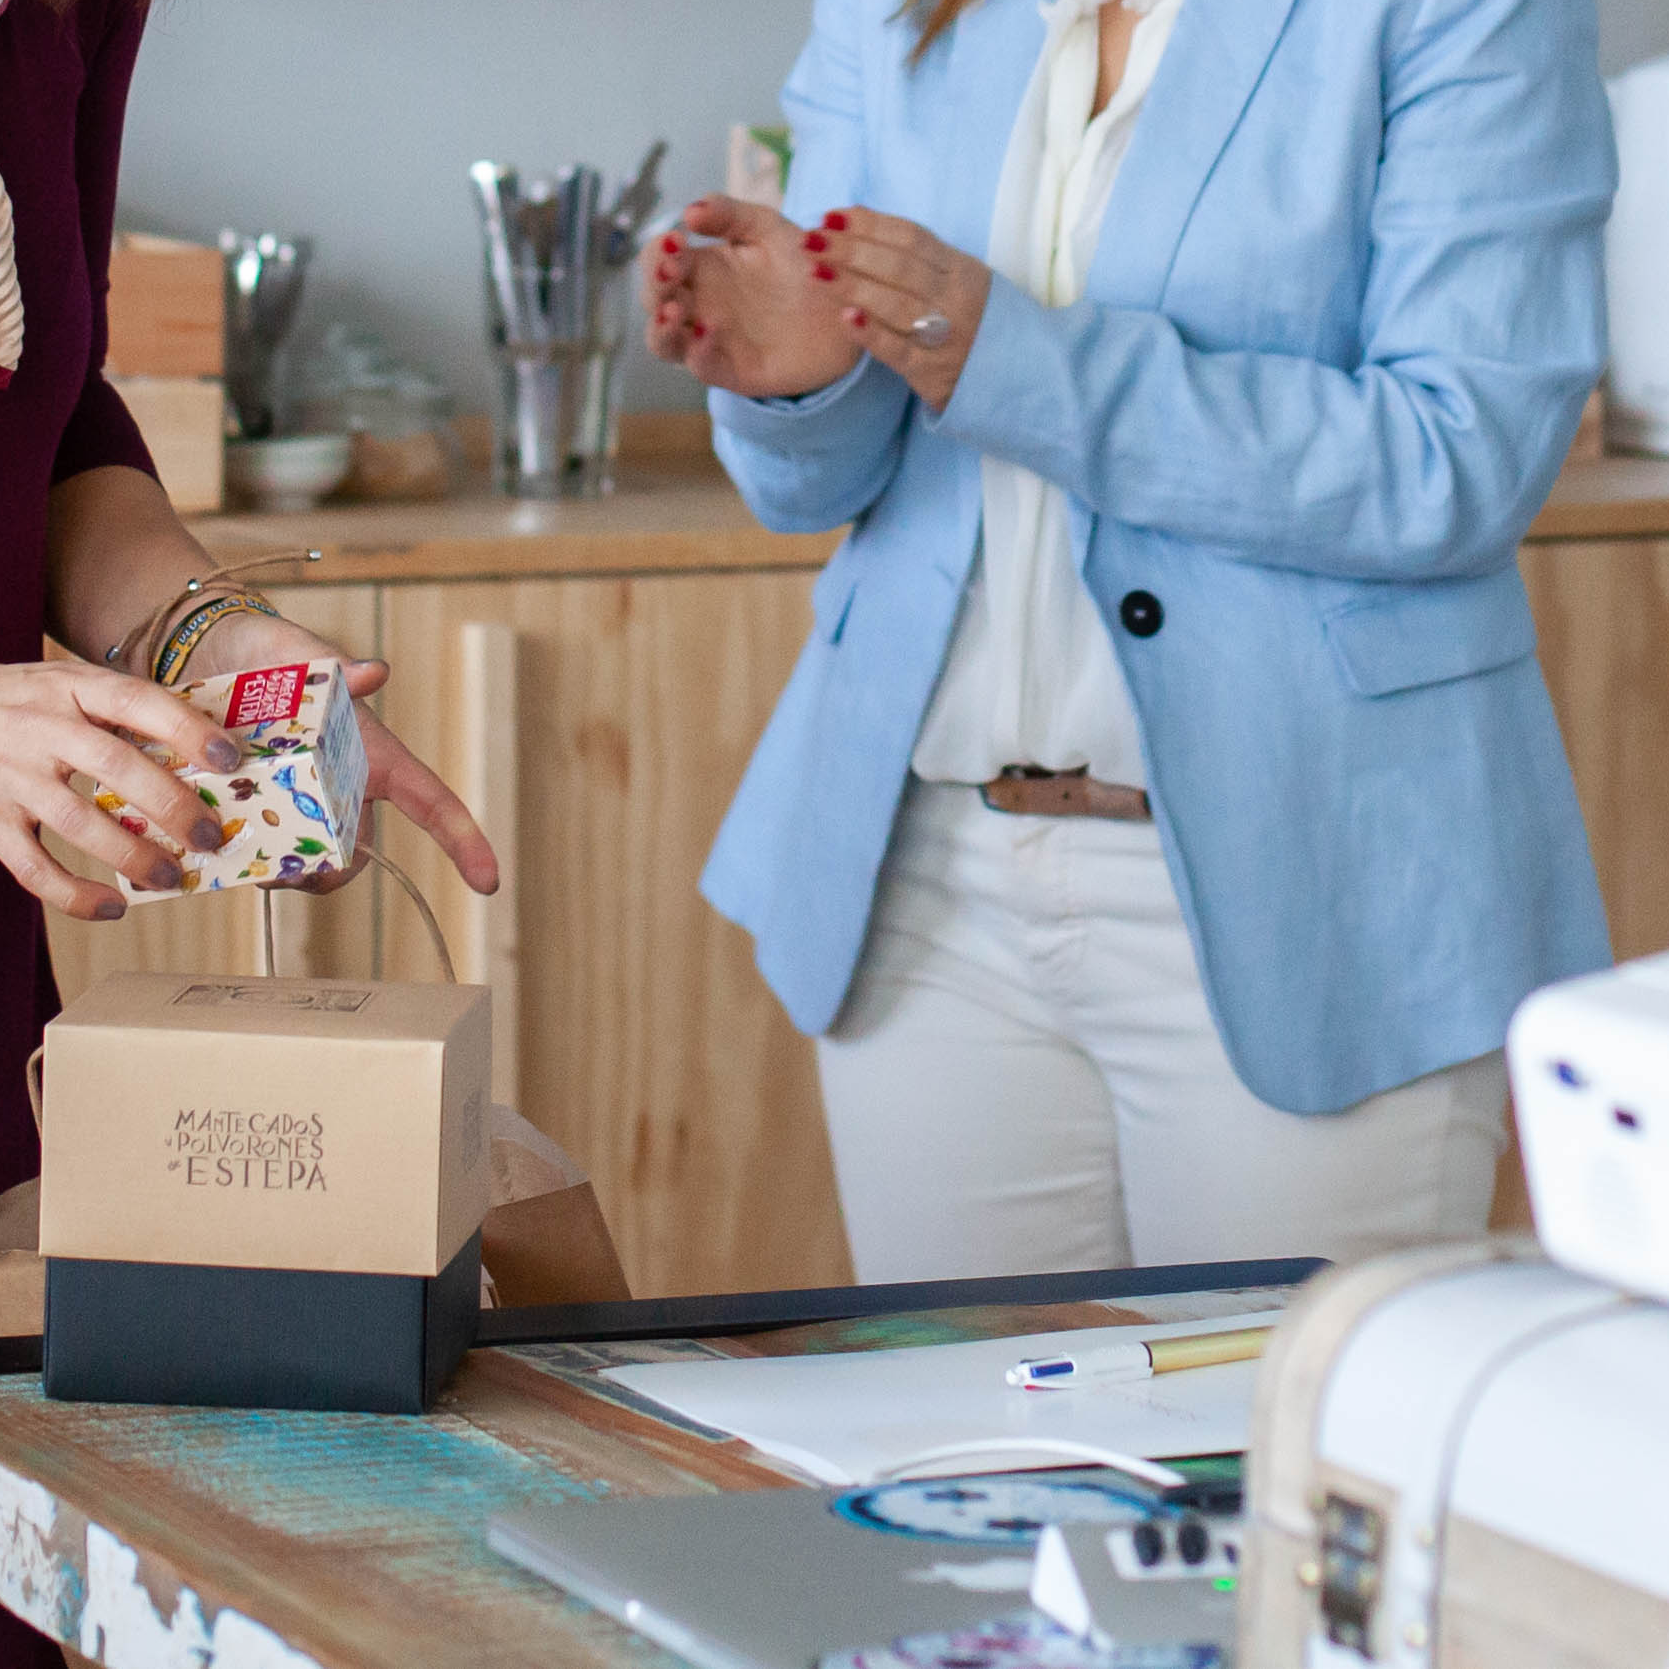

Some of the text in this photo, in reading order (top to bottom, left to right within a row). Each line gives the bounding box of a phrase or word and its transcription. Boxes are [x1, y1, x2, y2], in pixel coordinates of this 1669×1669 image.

[175, 1109, 323, 1136] MANTECADOS
[178, 1131, 323, 1159] POLVORONES
[187, 1156, 327, 1191] ESTEPA
